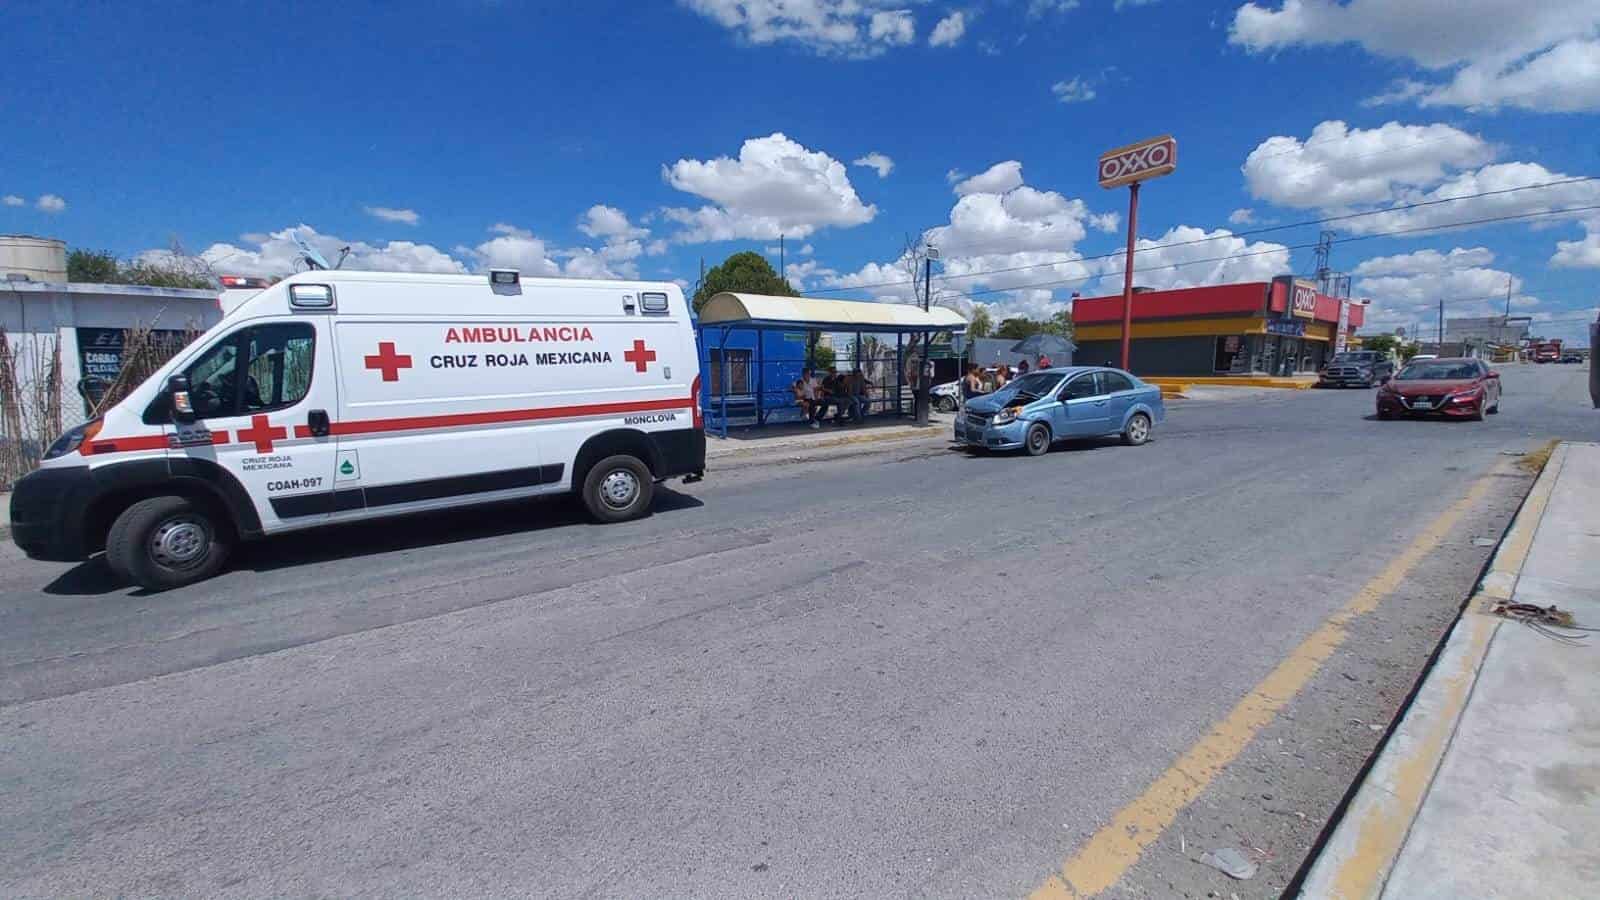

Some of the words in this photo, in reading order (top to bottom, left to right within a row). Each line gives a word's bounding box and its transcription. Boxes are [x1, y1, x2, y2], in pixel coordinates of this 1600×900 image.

[1102, 144, 1169, 179] OXXO
[1295, 288, 1316, 311] OXXO
[445, 326, 594, 343] AMBULANCIA
[430, 354, 478, 369] CRUZ
[485, 353, 529, 367] ROJA
[535, 351, 612, 366] MEXICANA
[624, 413, 677, 425] MONCLOVA
[242, 462, 293, 471] MEXICANA
[268, 455, 292, 463] ROJA
[267, 477, 323, 491] COAH-097
